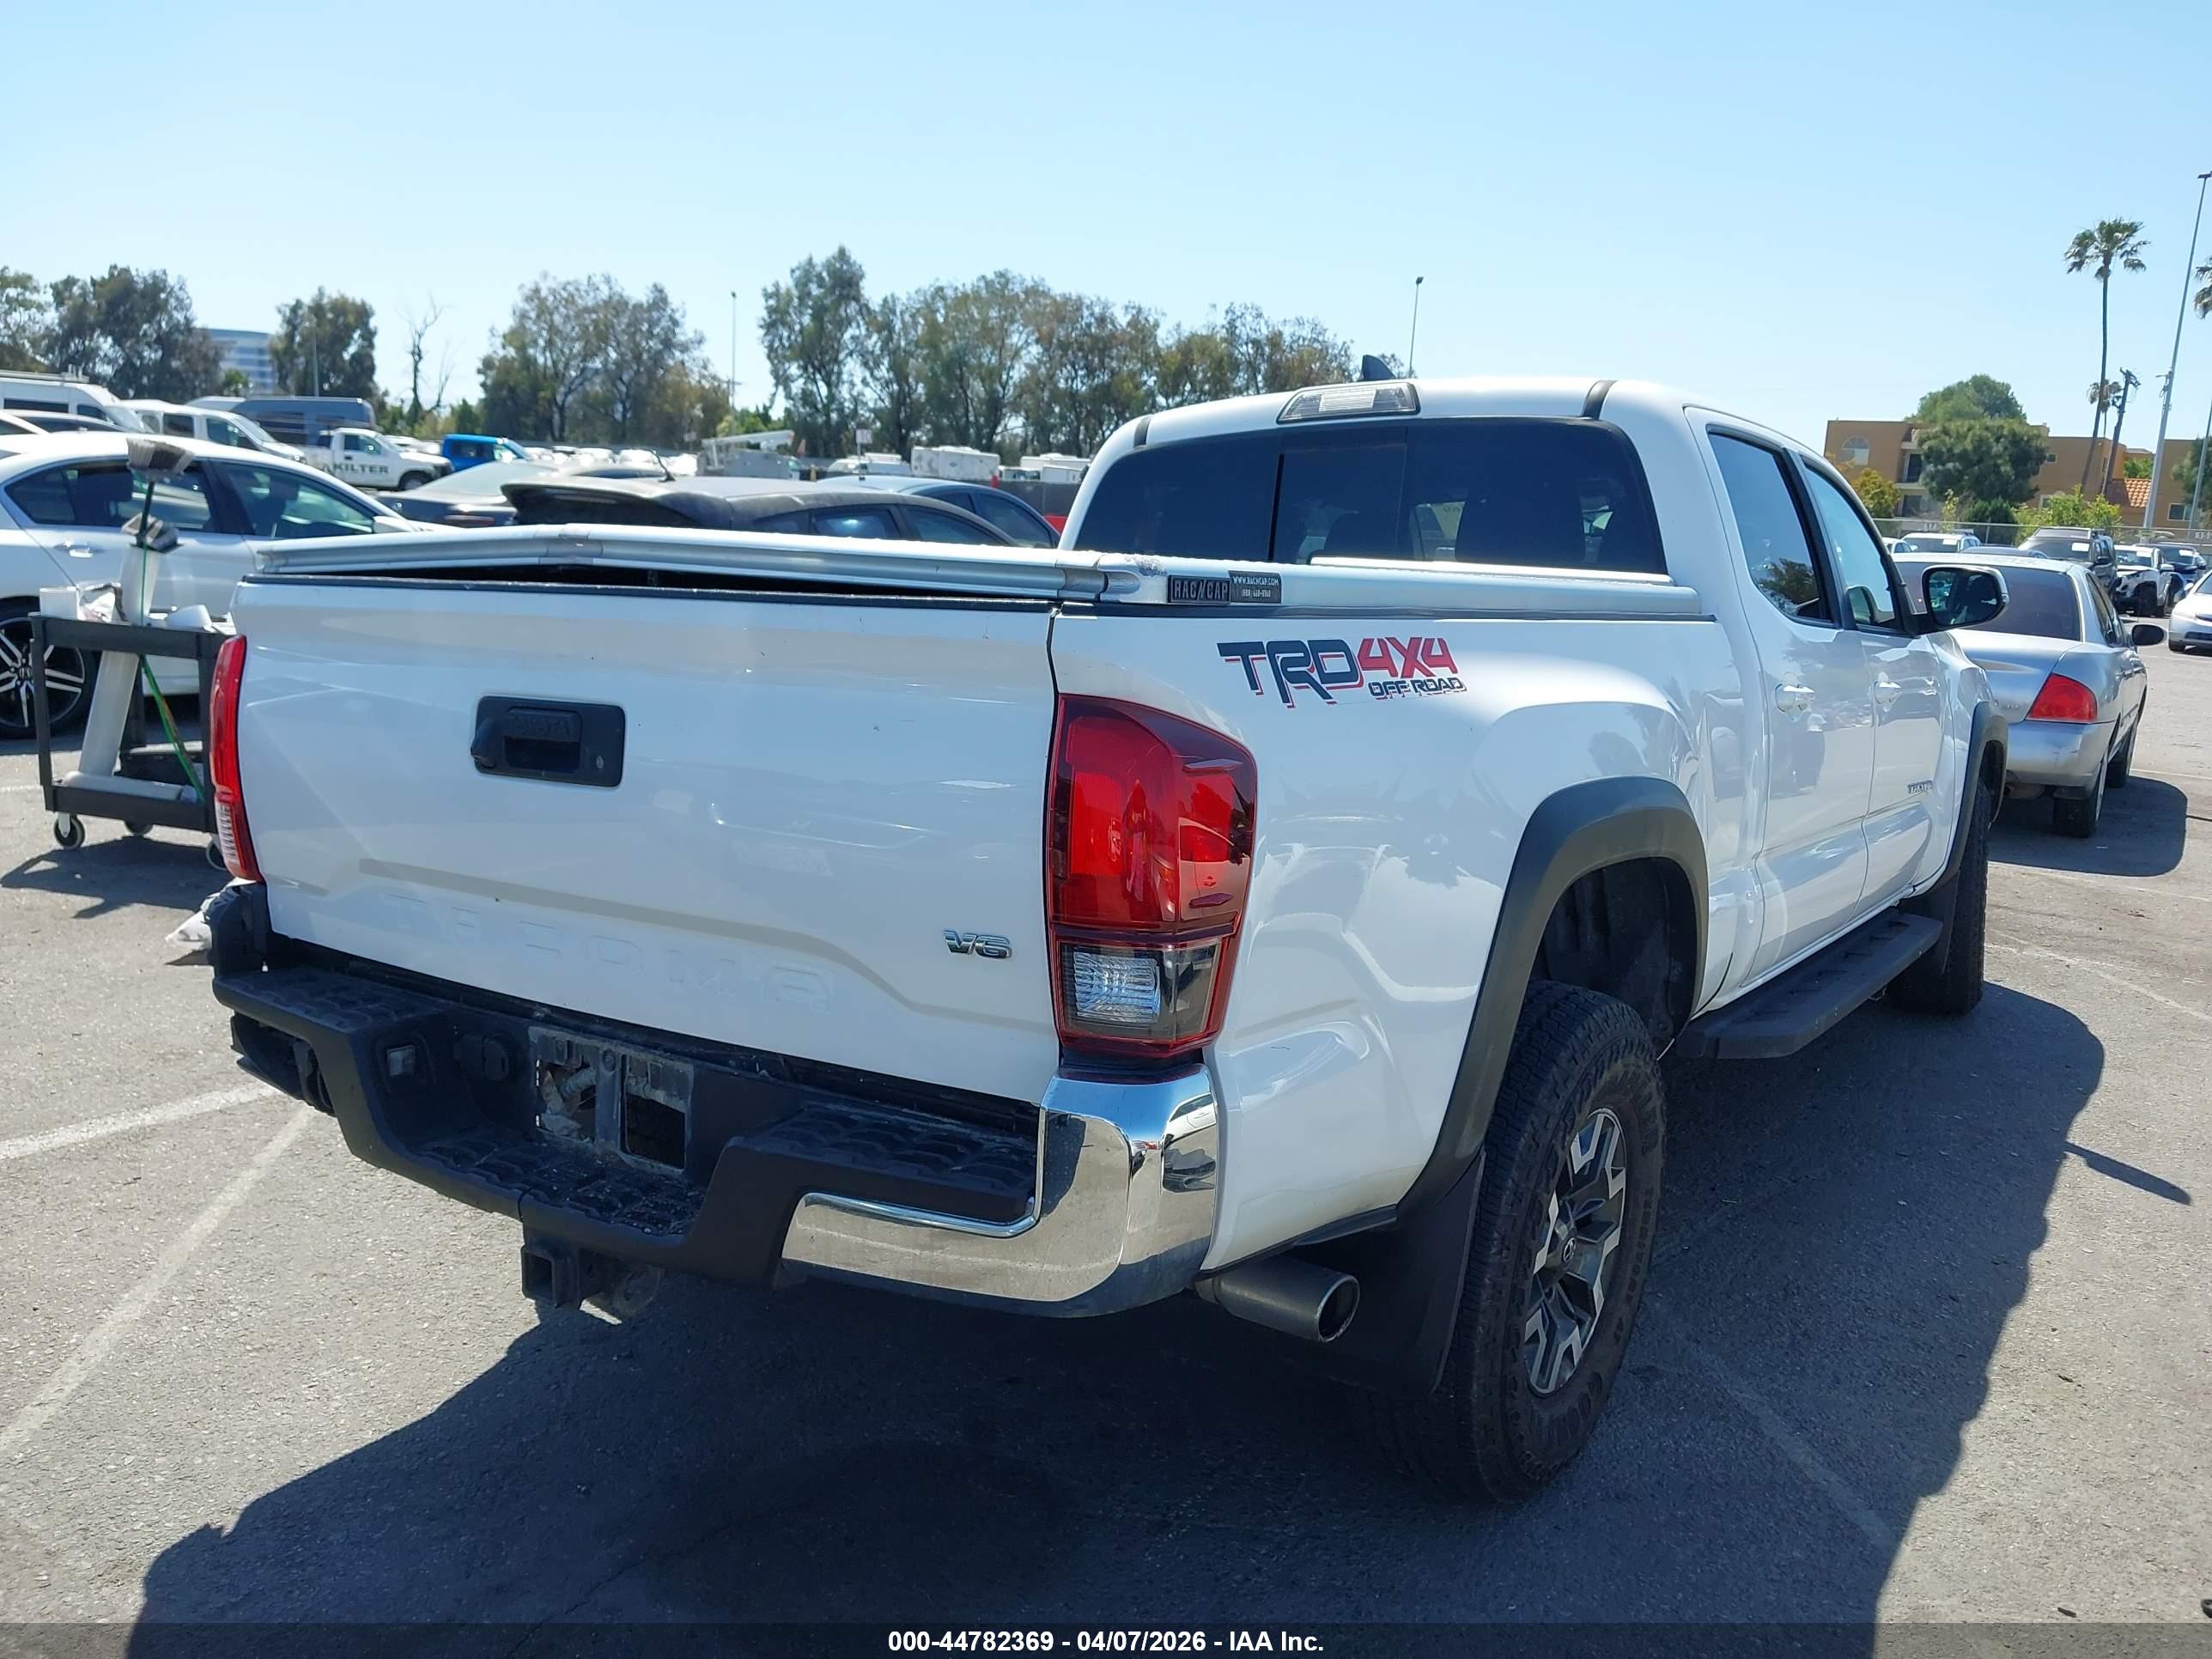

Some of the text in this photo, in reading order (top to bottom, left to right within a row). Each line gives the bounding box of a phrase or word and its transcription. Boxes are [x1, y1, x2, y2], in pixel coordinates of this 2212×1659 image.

[333, 463, 390, 475] KILTER
[1216, 636, 1460, 708] TRD 4X4
[1367, 677, 1468, 700] OFF ROAD
[942, 929, 1012, 960] V6
